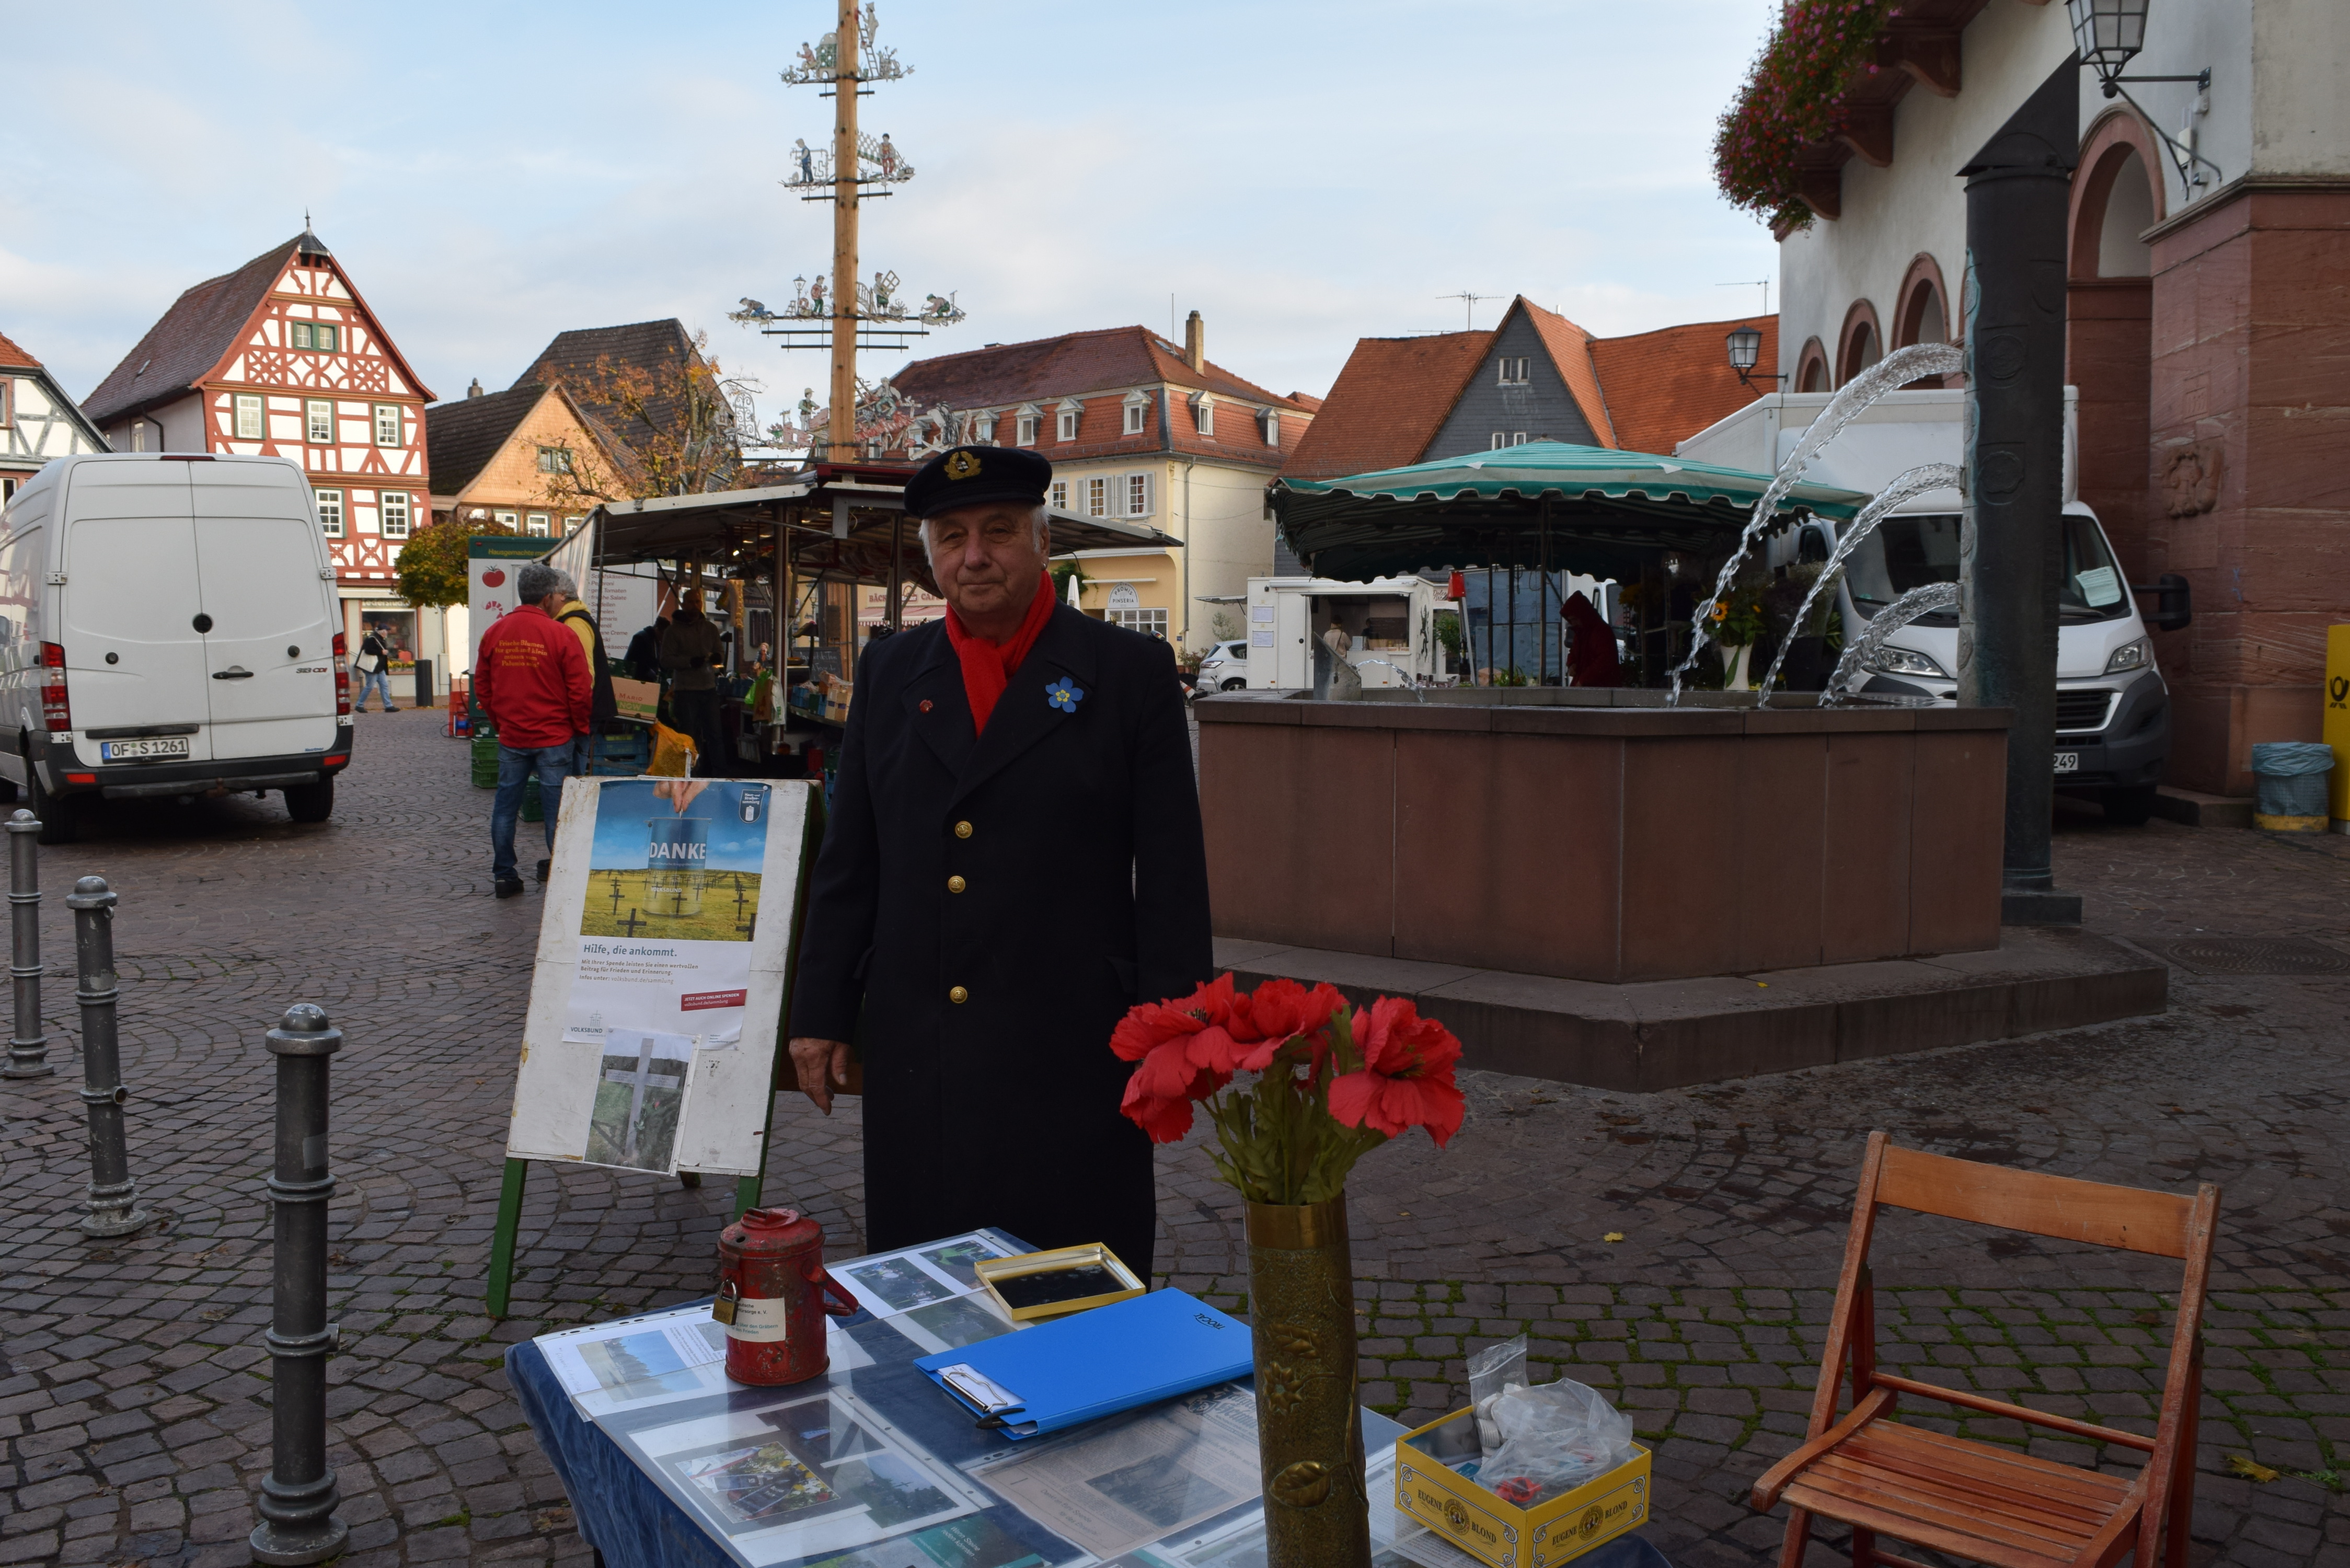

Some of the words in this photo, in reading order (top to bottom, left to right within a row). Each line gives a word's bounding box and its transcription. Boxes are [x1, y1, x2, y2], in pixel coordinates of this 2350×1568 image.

[1114, 586, 1133, 595] PROMIS
[521, 640, 544, 649] Blumen
[112, 744, 129, 756] OF
[140, 742, 148, 754] S
[152, 740, 187, 754] 1261
[650, 842, 706, 859] DANKE
[584, 944, 610, 955] Hilfe,
[613, 945, 627, 955] die
[629, 946, 677, 957] ankommt.
[1193, 1312, 1226, 1330] TROCAL
[1418, 1490, 1443, 1512] EUGENE
[1471, 1521, 1496, 1543] BLOND
[1552, 1526, 1577, 1546] EUGENE
[1605, 1501, 1628, 1519] BLOND
[941, 1529, 956, 1542] reden
[954, 1540, 975, 1557] könnten
[950, 1526, 965, 1539] Wenn
[964, 1537, 981, 1551] Steine
